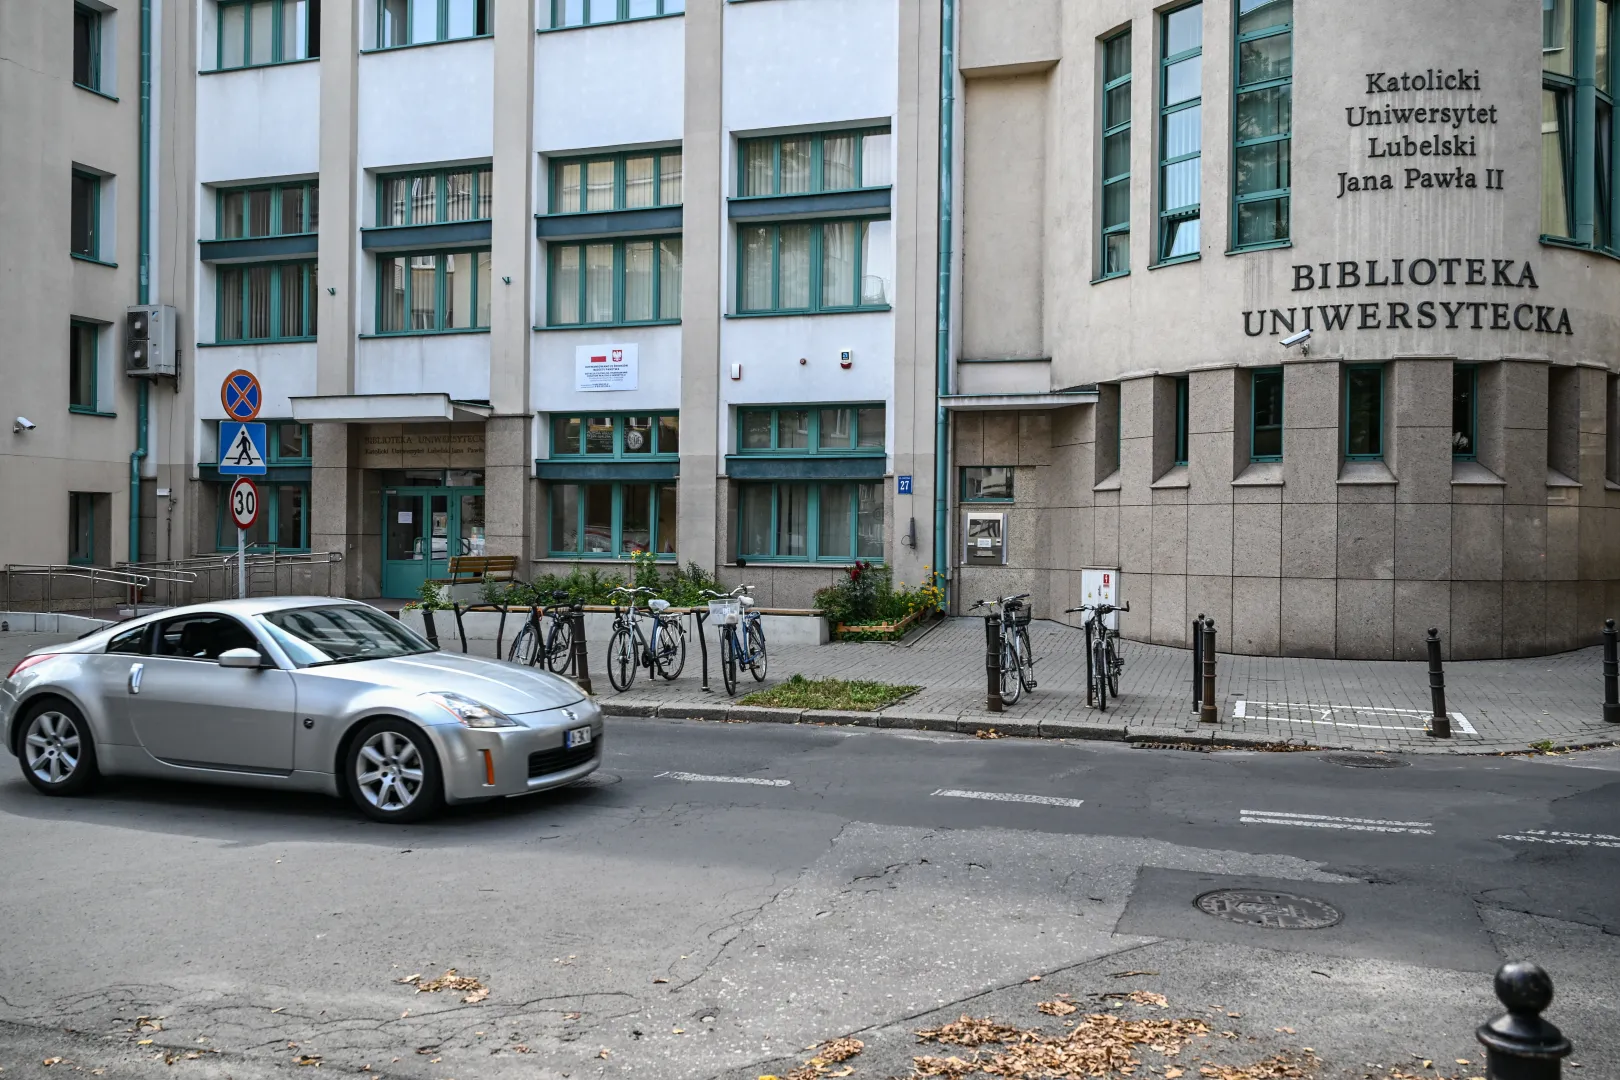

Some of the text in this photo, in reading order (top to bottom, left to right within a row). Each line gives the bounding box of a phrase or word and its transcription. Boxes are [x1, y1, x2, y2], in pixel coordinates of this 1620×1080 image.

[1366, 68, 1481, 94] Katolicki
[1345, 103, 1498, 129] Uniwersytet
[1367, 134, 1477, 159] Lubelski
[1336, 166, 1505, 199] Jana Pawła II
[1291, 257, 1540, 292] BIBLIOTEKA
[1242, 300, 1575, 337] UNIWERSYTECKA
[364, 436, 413, 445] BIBLIOTEKA
[900, 480, 910, 491] 27
[235, 490, 255, 516] 30
